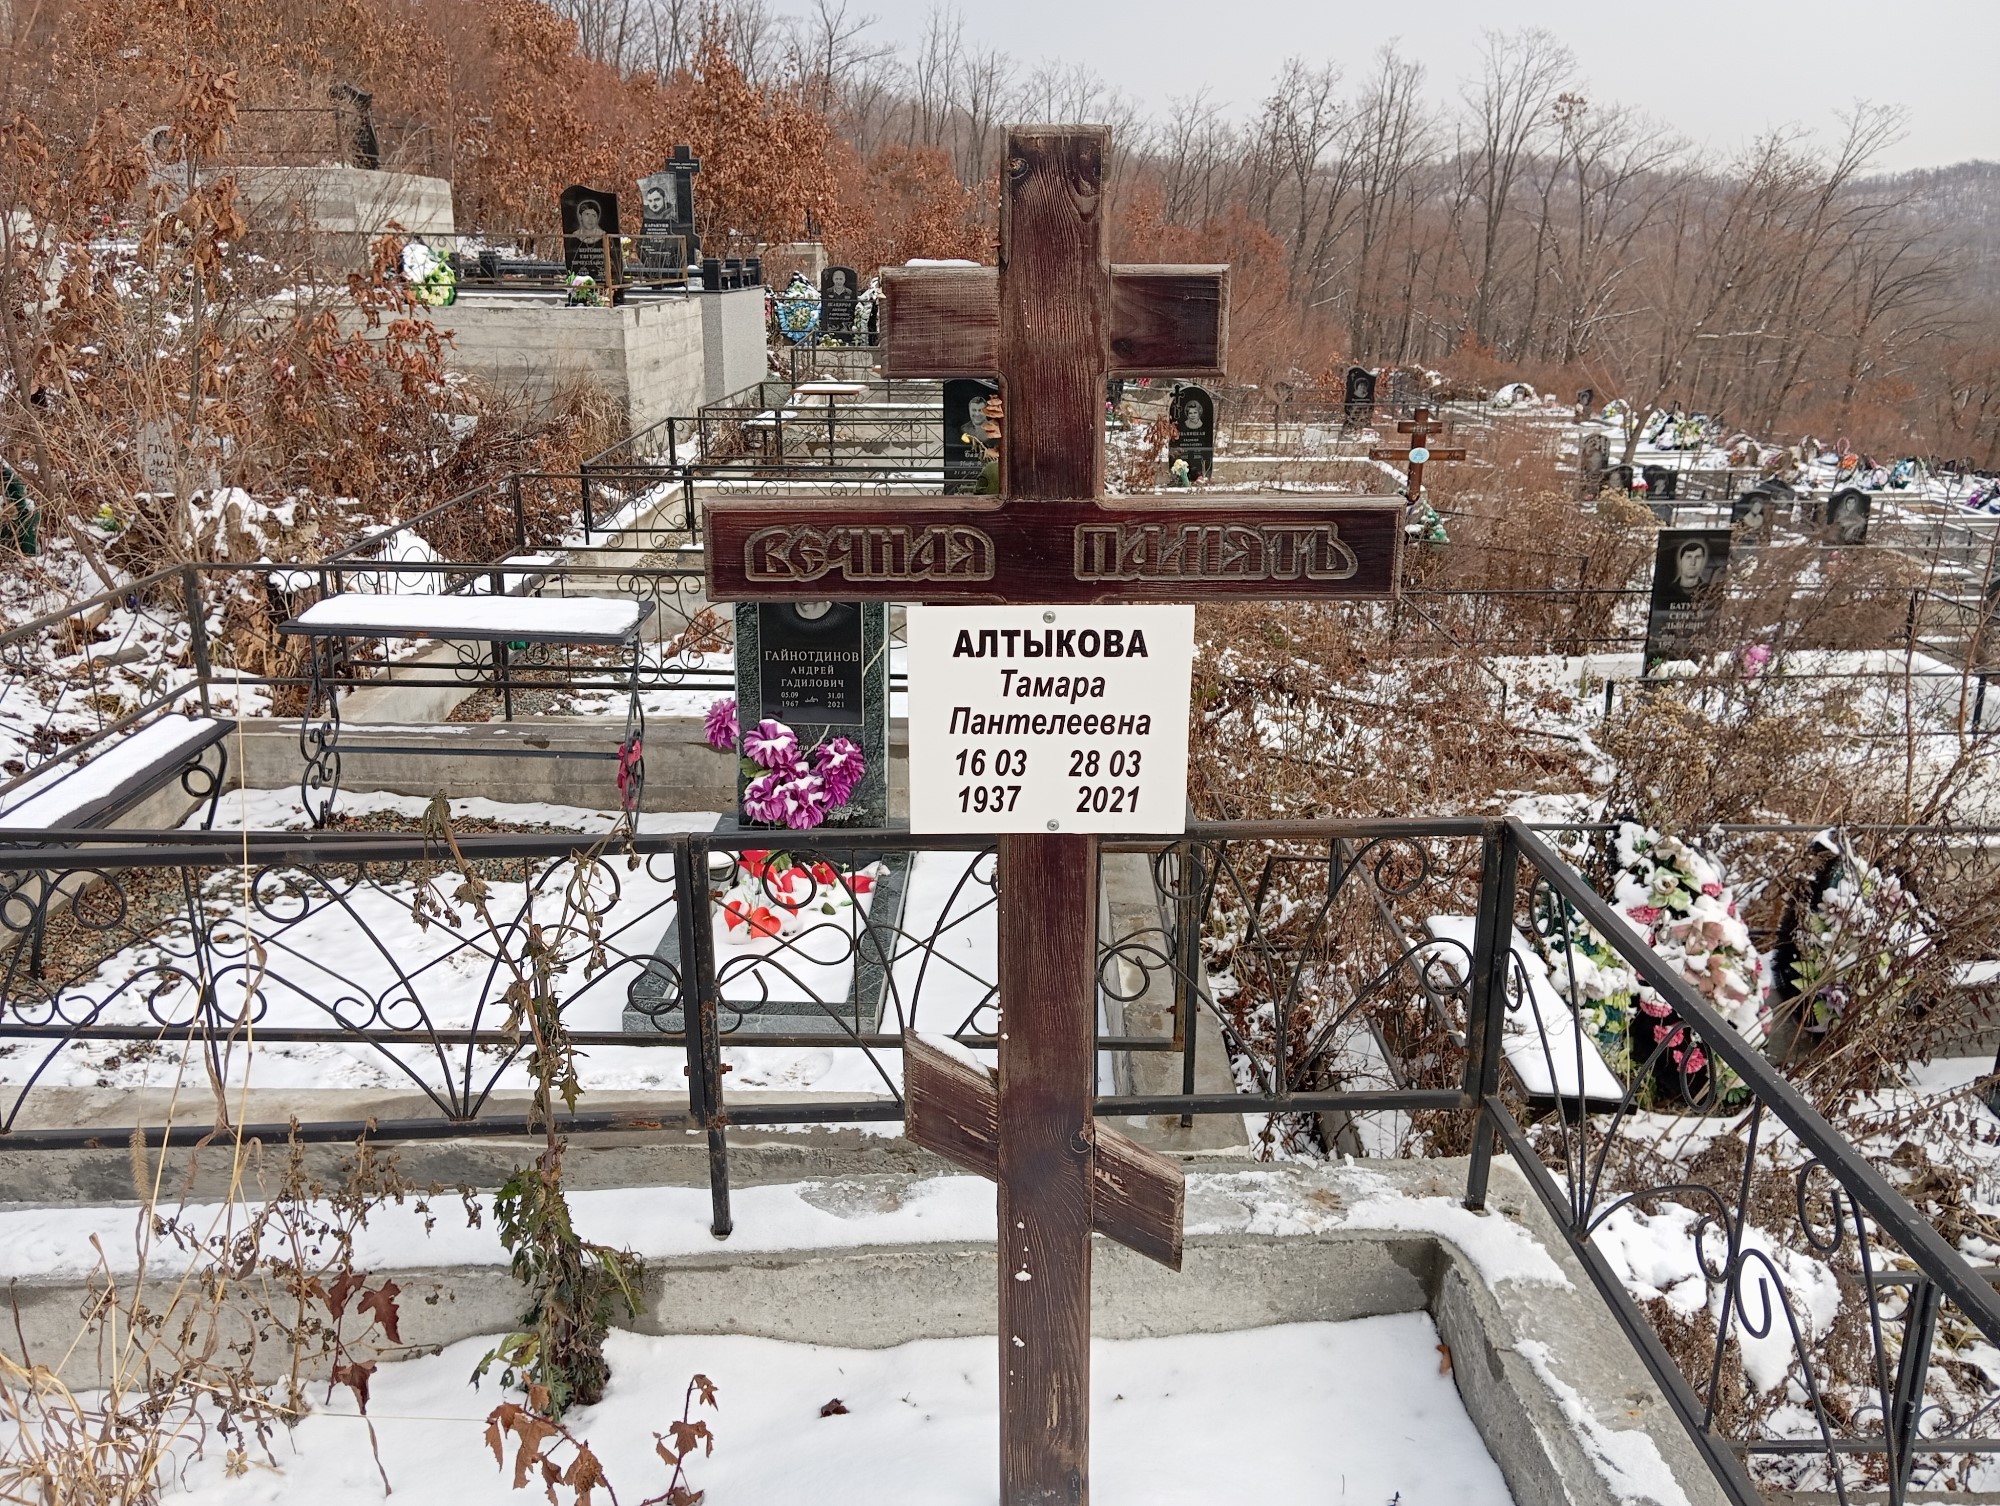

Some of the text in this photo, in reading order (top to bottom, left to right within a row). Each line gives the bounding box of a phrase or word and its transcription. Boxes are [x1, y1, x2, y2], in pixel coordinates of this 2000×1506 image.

[744, 522, 1358, 582] ВЕЧНАЯ ПАМЯТЬ
[765, 648, 859, 663] ГАЙНОТДИНОВ
[952, 629, 1149, 658] АЛТЫКОВА
[780, 678, 844, 688] ГАДИЛОВИЧ
[790, 664, 834, 675] АНДРЕЙ
[1000, 669, 1106, 704] Тамара
[949, 706, 1151, 736] Пантелеевна
[955, 748, 1142, 778] 16 03 28 03
[958, 785, 1140, 814] 1937 2021
